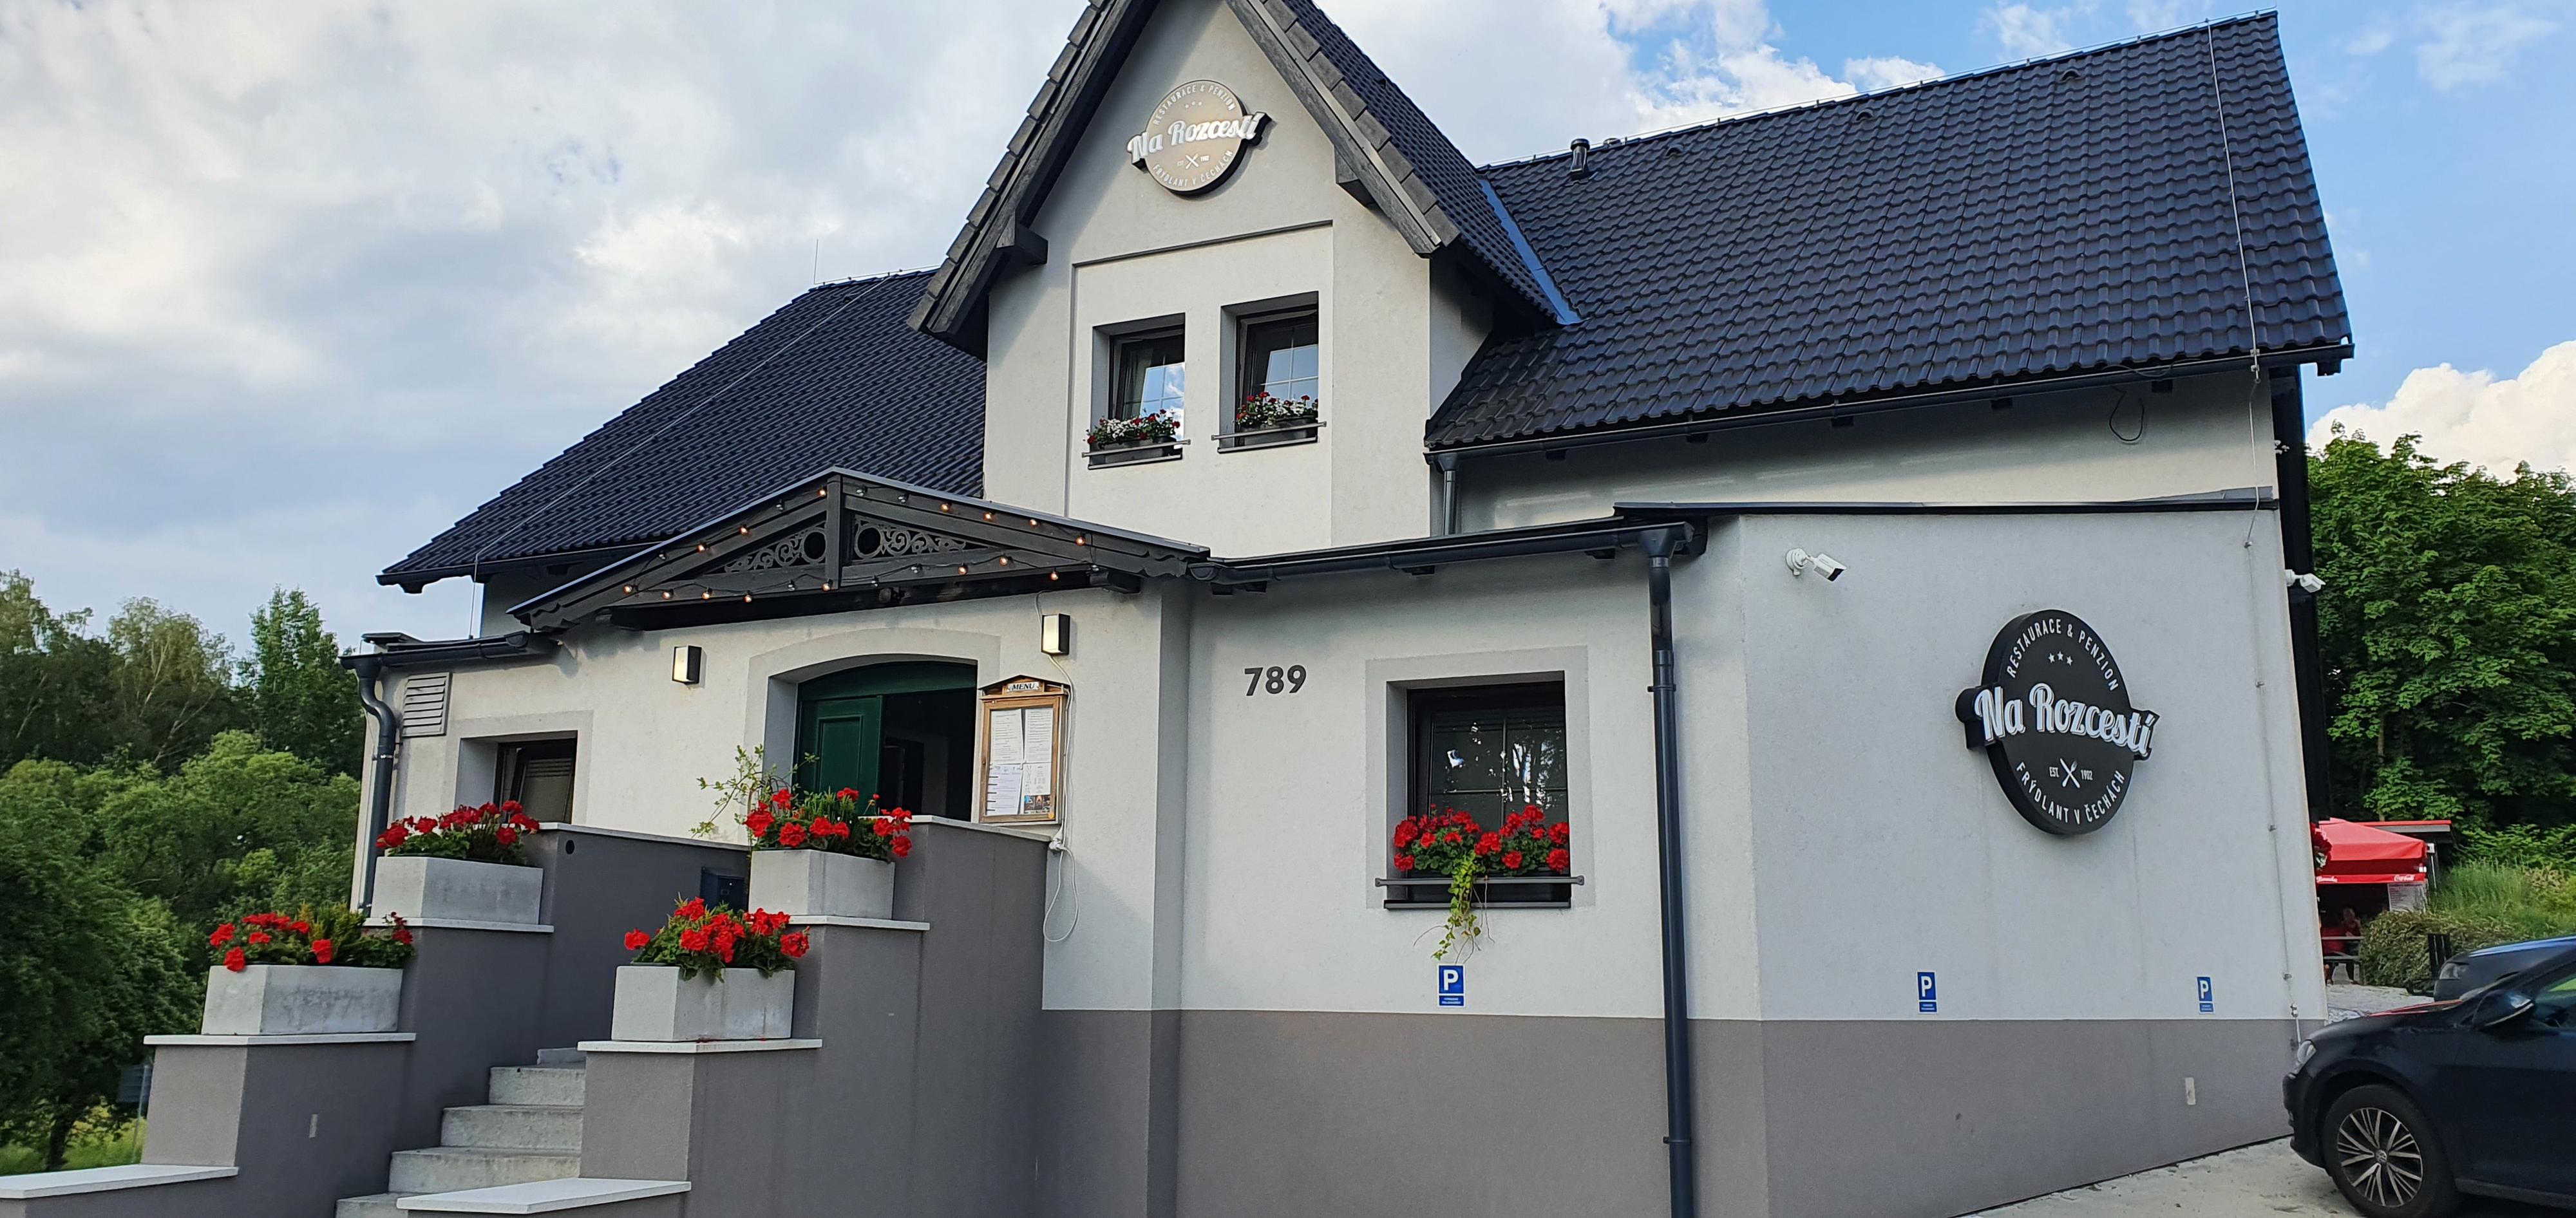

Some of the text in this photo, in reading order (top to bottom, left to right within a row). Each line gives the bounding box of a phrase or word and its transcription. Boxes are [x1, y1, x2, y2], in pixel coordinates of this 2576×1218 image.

[1153, 85, 1196, 125] RESTAURACE
[1208, 85, 1236, 111] PENZION
[1127, 112, 1265, 163] Na Rozcestí
[2006, 618, 2119, 691] RESTAURACE & PENZION
[1244, 664, 1306, 696] 789
[1974, 682, 2156, 756] Na Rozcestí
[2016, 762, 2125, 824] FRÝDLANT V ČECHÁCH
[1443, 970, 1459, 991] P
[1921, 976, 1932, 997] P
[2199, 980, 2209, 998] P
